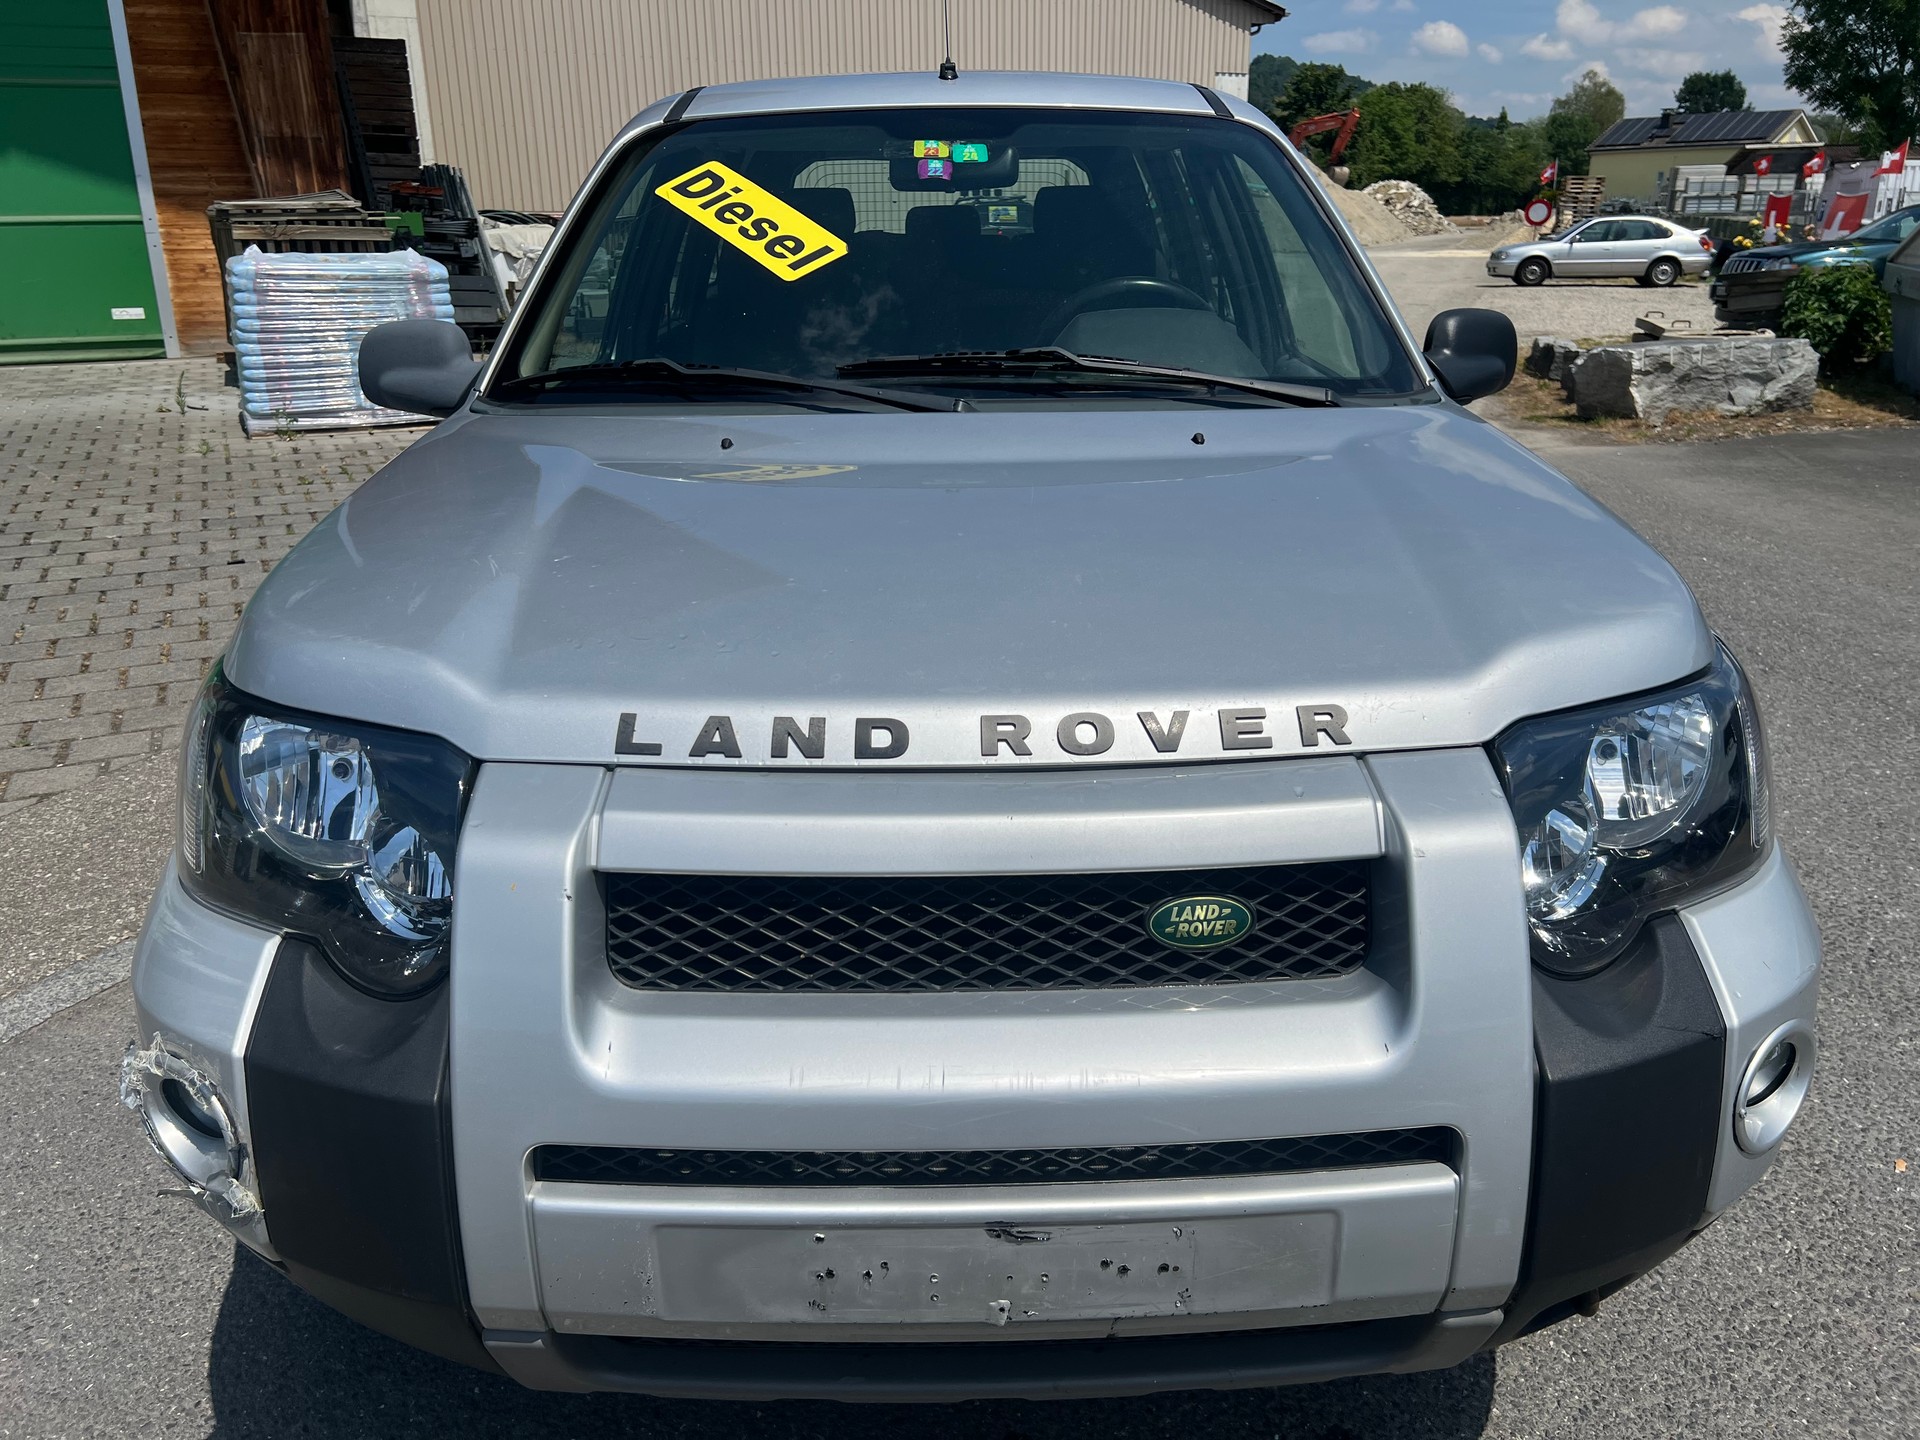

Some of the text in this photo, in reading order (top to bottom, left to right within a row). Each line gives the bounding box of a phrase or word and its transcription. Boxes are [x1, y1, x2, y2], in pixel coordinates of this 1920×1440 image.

[924, 147, 939, 156] 23
[963, 152, 978, 161] 24
[928, 167, 943, 176] 22
[670, 169, 835, 271] Diesel
[615, 703, 1353, 759] LAND ROVER
